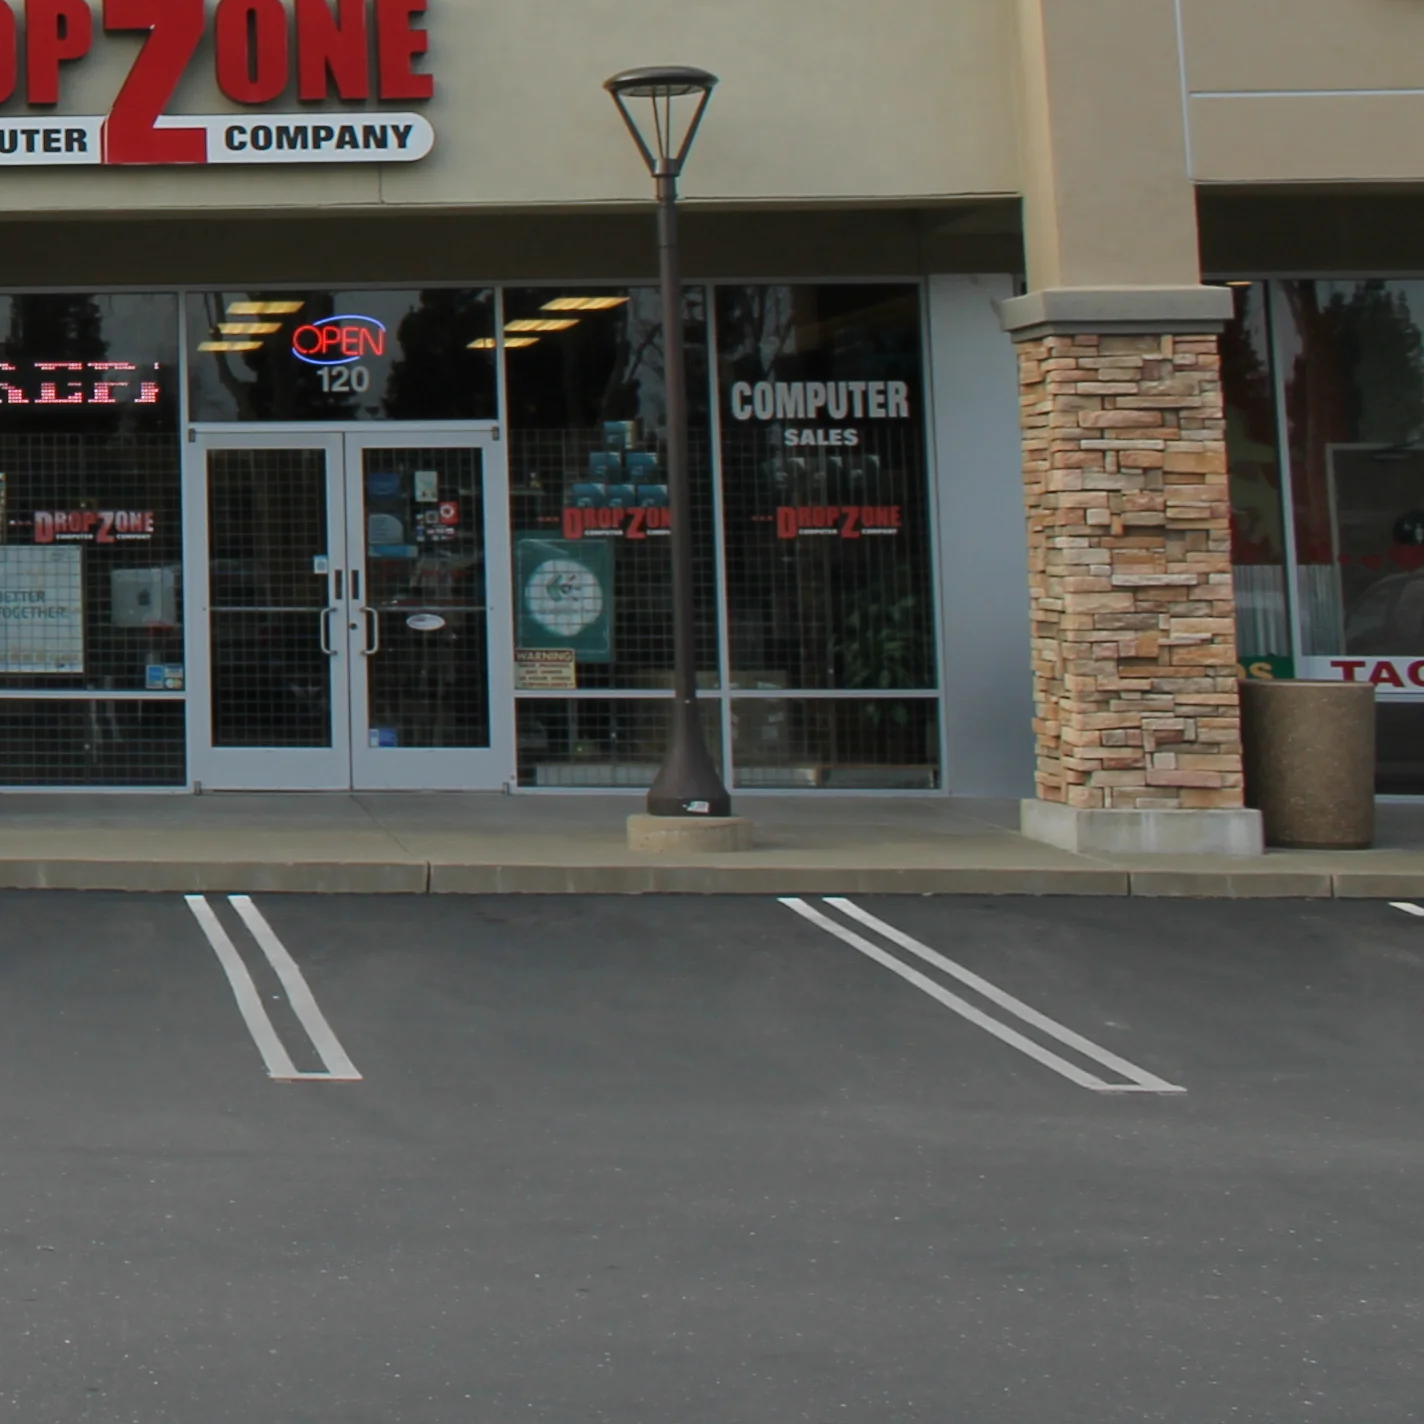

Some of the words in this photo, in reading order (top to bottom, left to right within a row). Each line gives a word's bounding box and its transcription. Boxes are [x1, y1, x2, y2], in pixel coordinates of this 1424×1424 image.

[223, 124, 414, 152] COMPANY
[292, 324, 385, 356] OPEN
[316, 365, 370, 392] 120
[731, 380, 910, 421] COMPUTER
[784, 428, 859, 447] SALES
[563, 507, 672, 540] DROPZON
